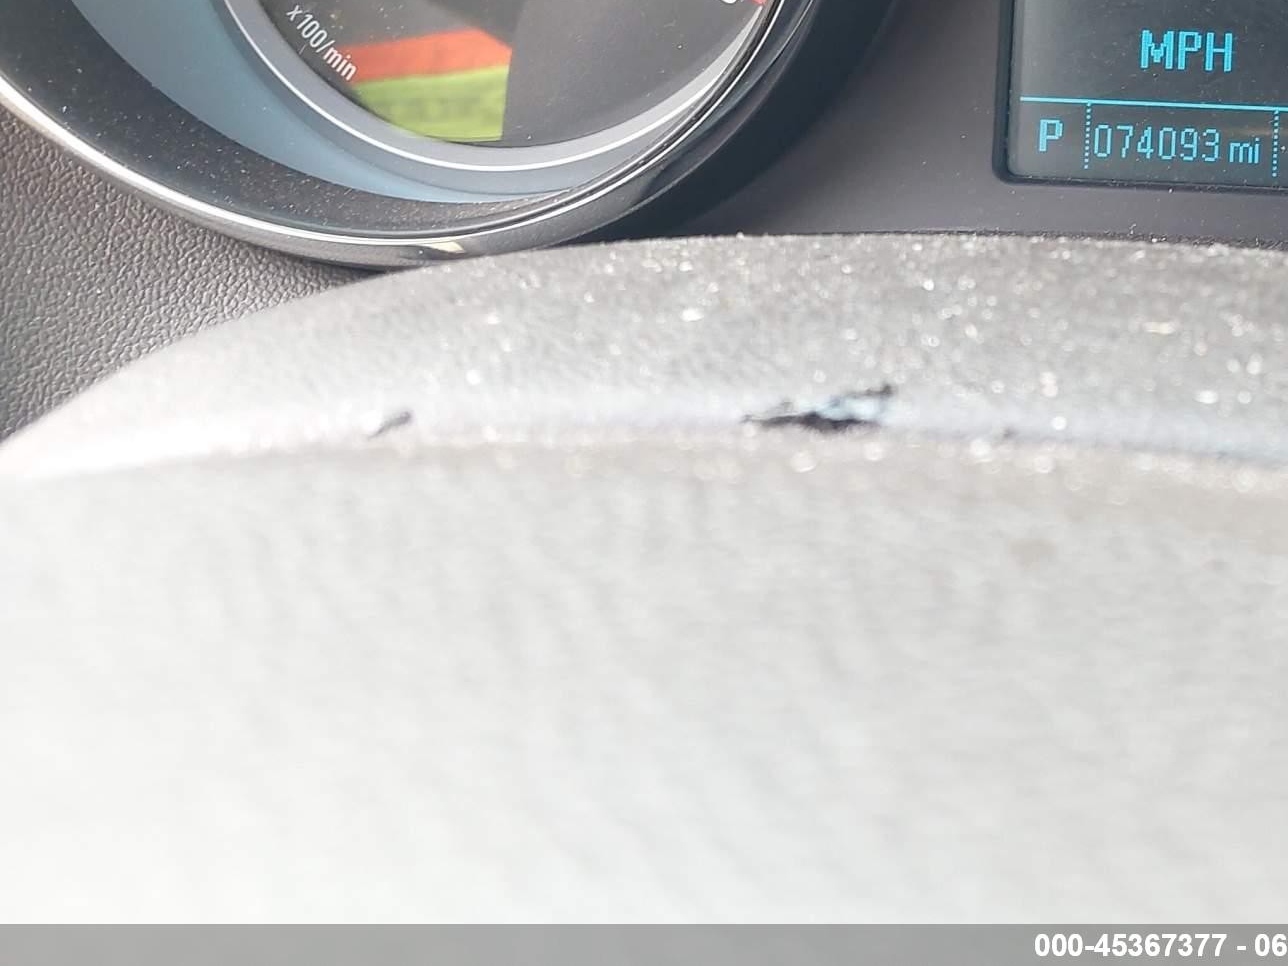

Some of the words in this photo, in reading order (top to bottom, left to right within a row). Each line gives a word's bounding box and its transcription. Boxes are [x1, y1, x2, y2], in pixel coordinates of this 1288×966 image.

[286, 3, 358, 83] x100/min
[1140, 29, 1233, 73] MPH
[1038, 118, 1064, 152] P
[1093, 124, 1220, 163] 074093
[1228, 137, 1261, 165] mi
